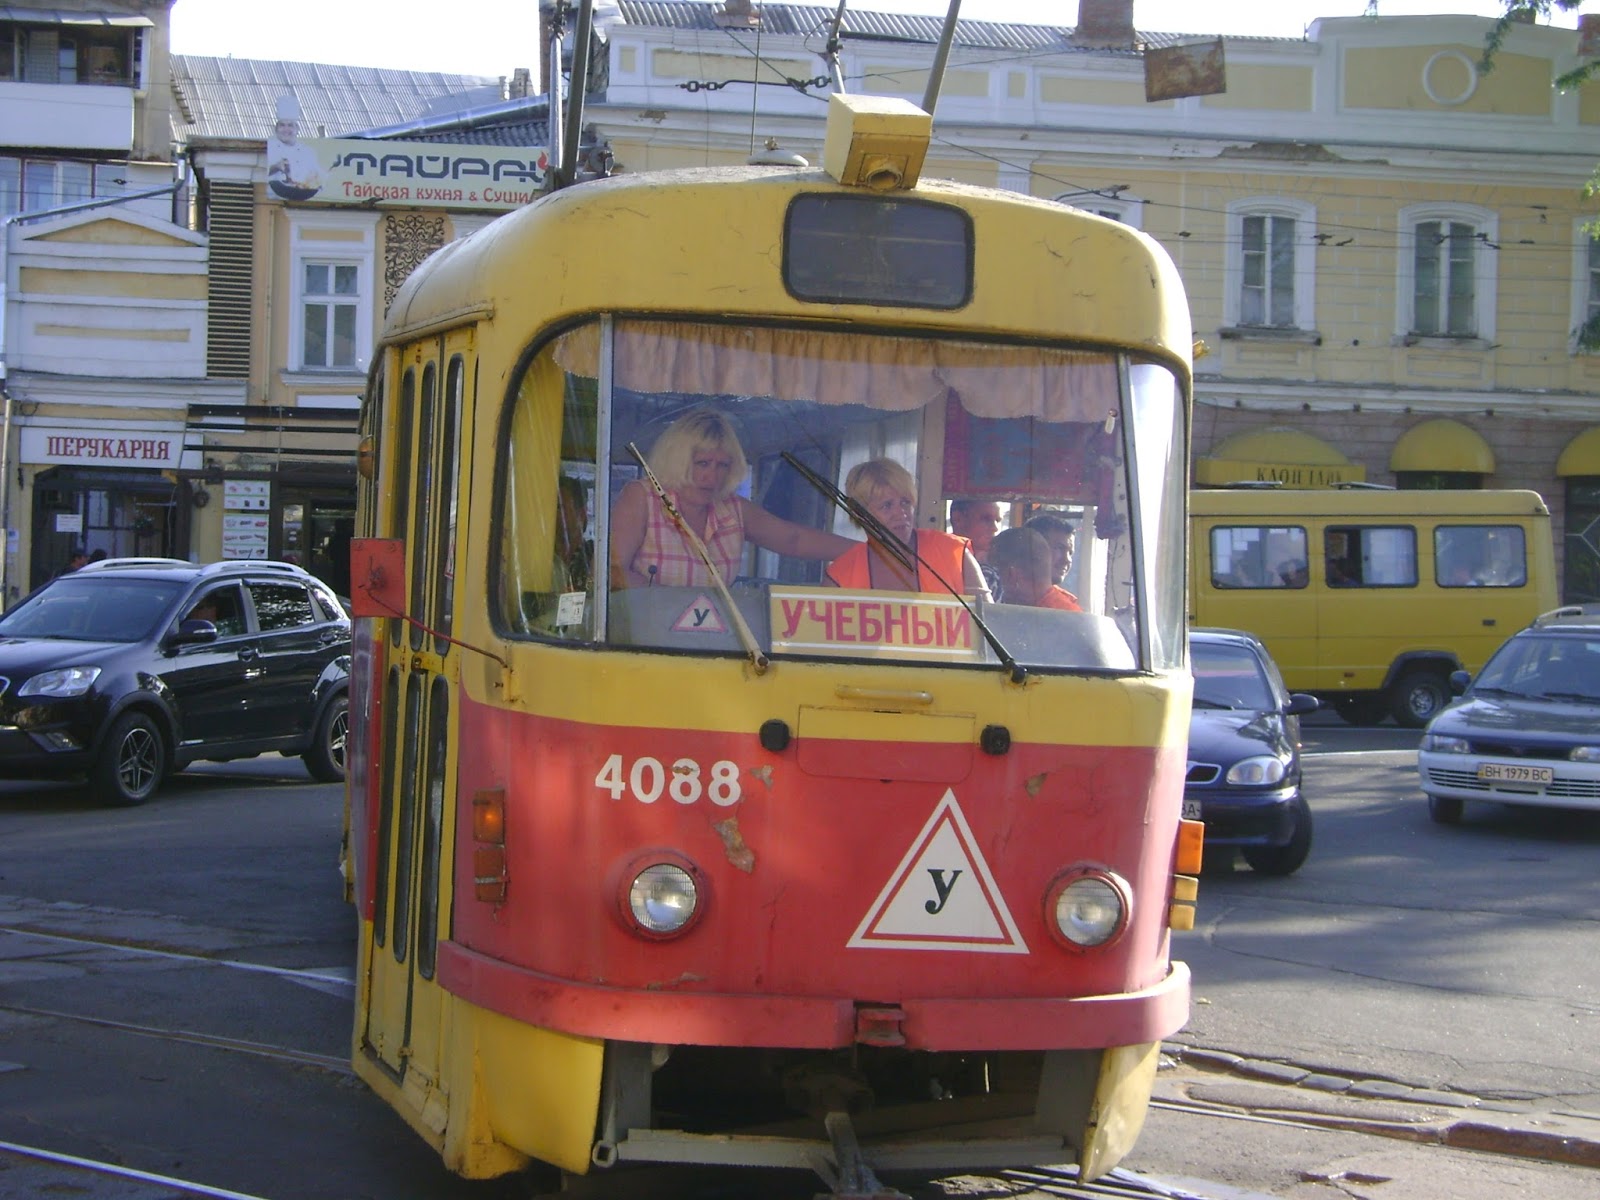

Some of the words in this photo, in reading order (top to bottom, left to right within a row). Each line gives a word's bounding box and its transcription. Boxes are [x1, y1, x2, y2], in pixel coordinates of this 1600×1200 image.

[342, 181, 410, 199] Тайская
[416, 187, 463, 202] кухня
[469, 193, 478, 202] &
[483, 188, 529, 204] Суши
[47, 436, 170, 460] ПЕРУКАРНЯ
[781, 600, 972, 647] УЧЕБНЫЙ
[595, 753, 742, 806] 4088
[1485, 766, 1501, 777] BH
[1505, 767, 1529, 780] 1979
[925, 869, 963, 915] У
